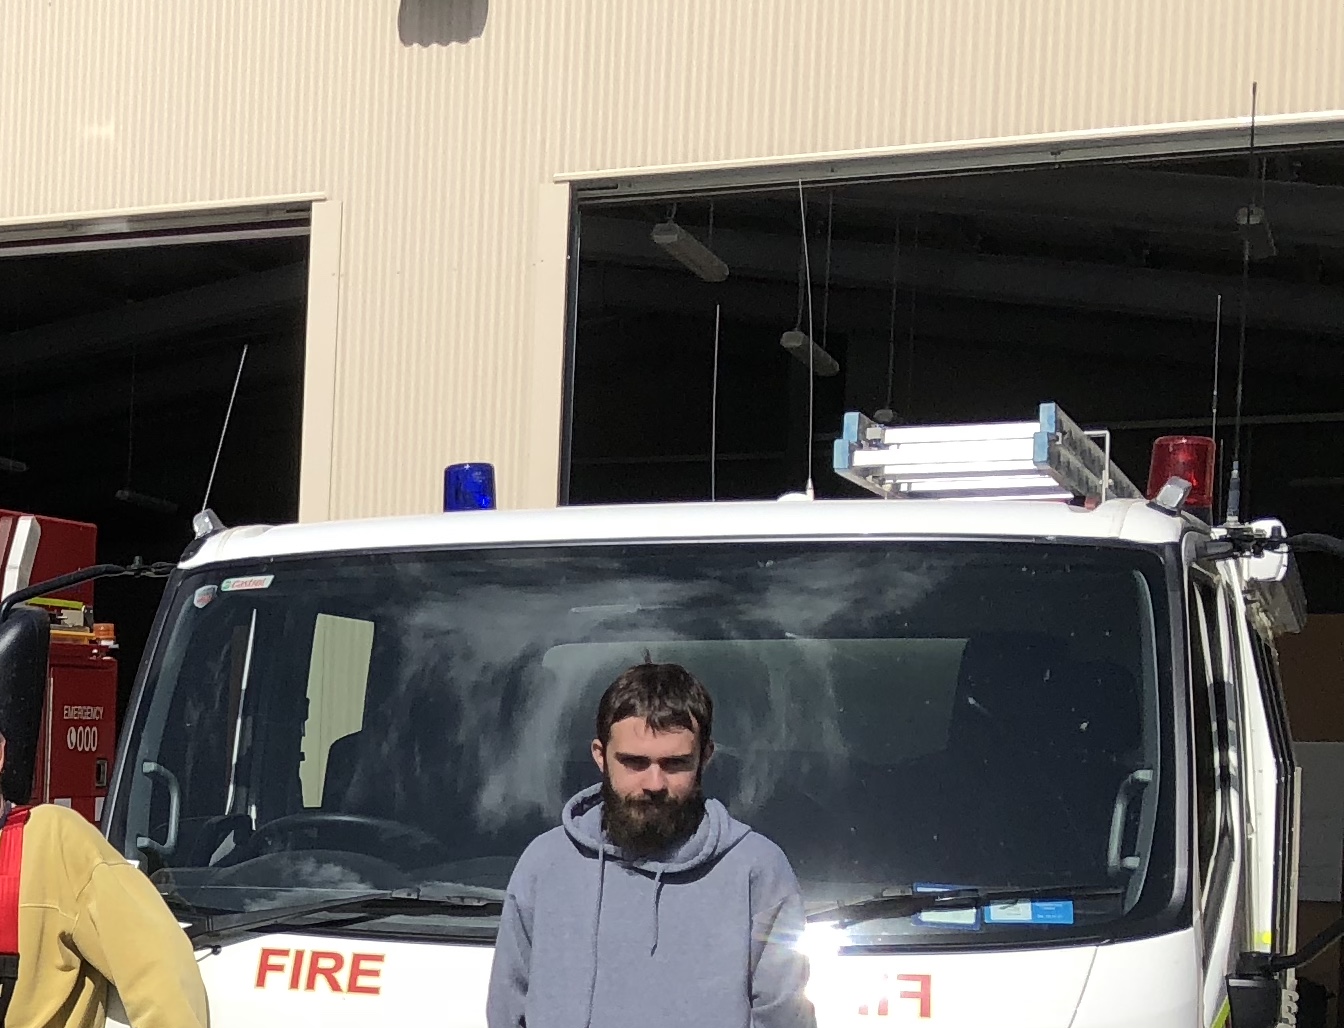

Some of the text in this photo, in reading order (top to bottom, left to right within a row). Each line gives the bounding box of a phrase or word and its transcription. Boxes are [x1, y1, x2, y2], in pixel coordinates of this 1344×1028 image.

[63, 705, 104, 720] EMERGENCY
[77, 725, 98, 752] 000
[254, 947, 386, 996] FIRE
